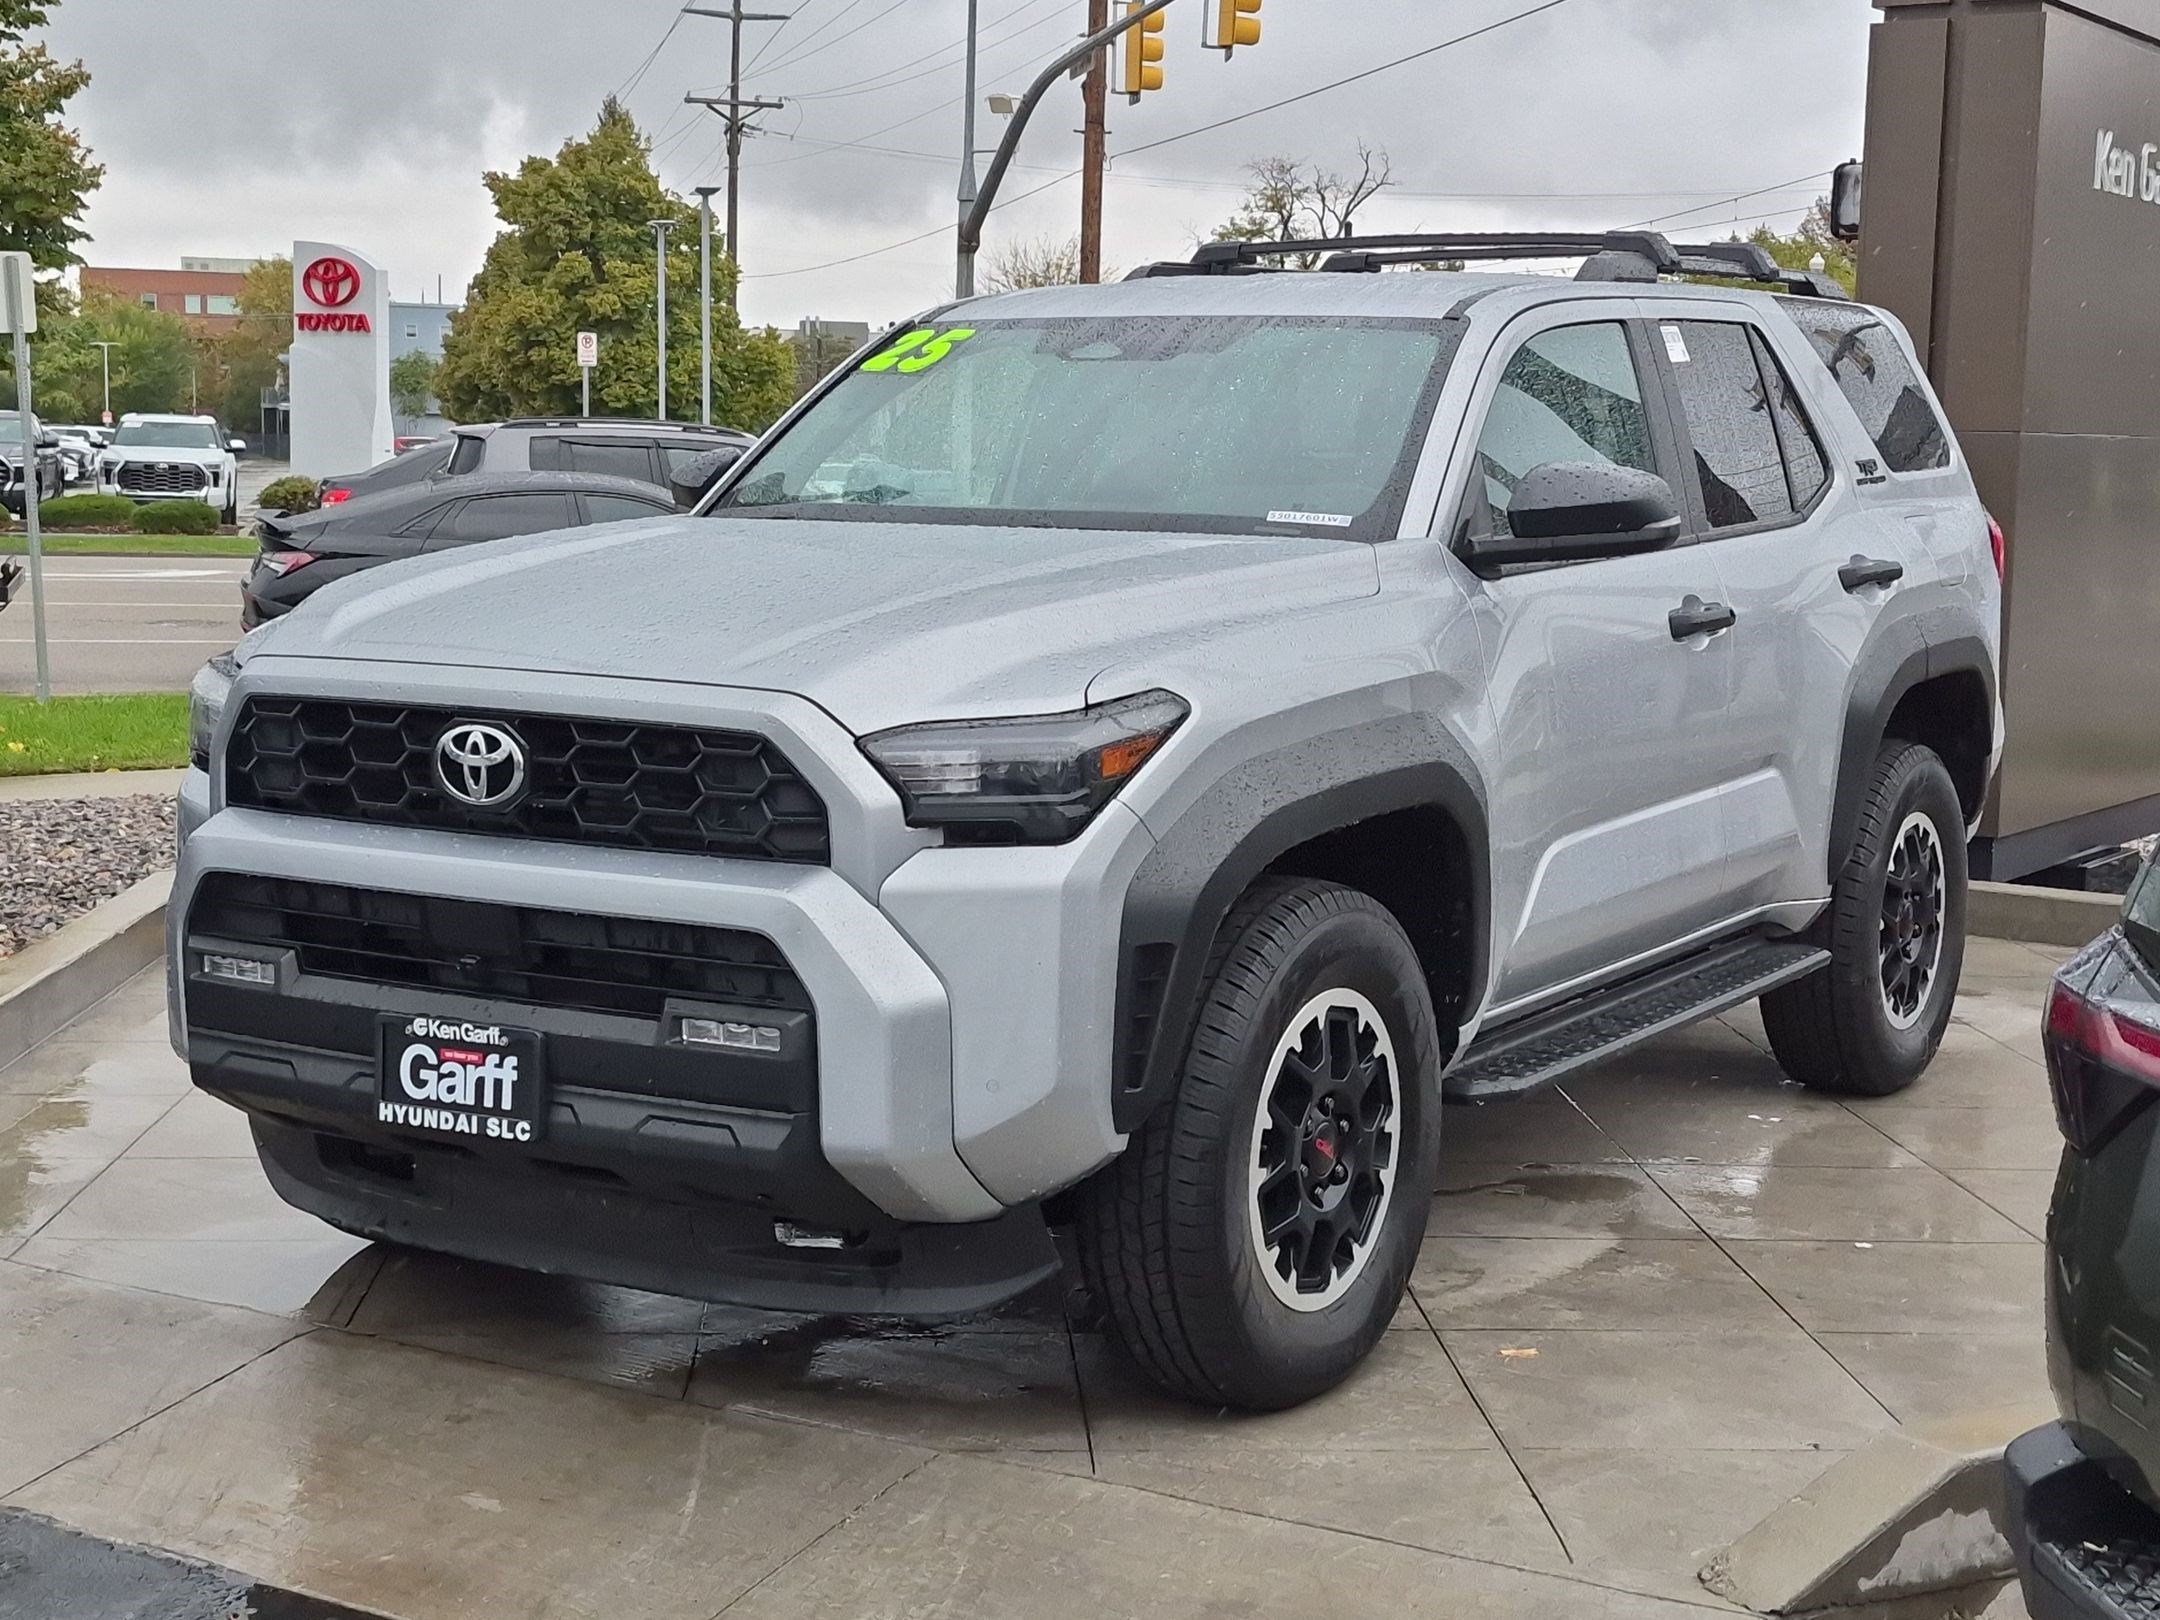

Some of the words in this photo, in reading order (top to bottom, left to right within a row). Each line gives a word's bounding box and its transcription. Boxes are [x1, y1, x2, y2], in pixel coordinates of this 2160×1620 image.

[2093, 128, 2135, 198] Ken
[295, 312, 371, 333] TOYOTA
[860, 329, 976, 372] 25
[400, 1043, 518, 1110] Garff
[379, 1102, 478, 1134] HYUNDAI
[486, 1117, 531, 1141] SLC
